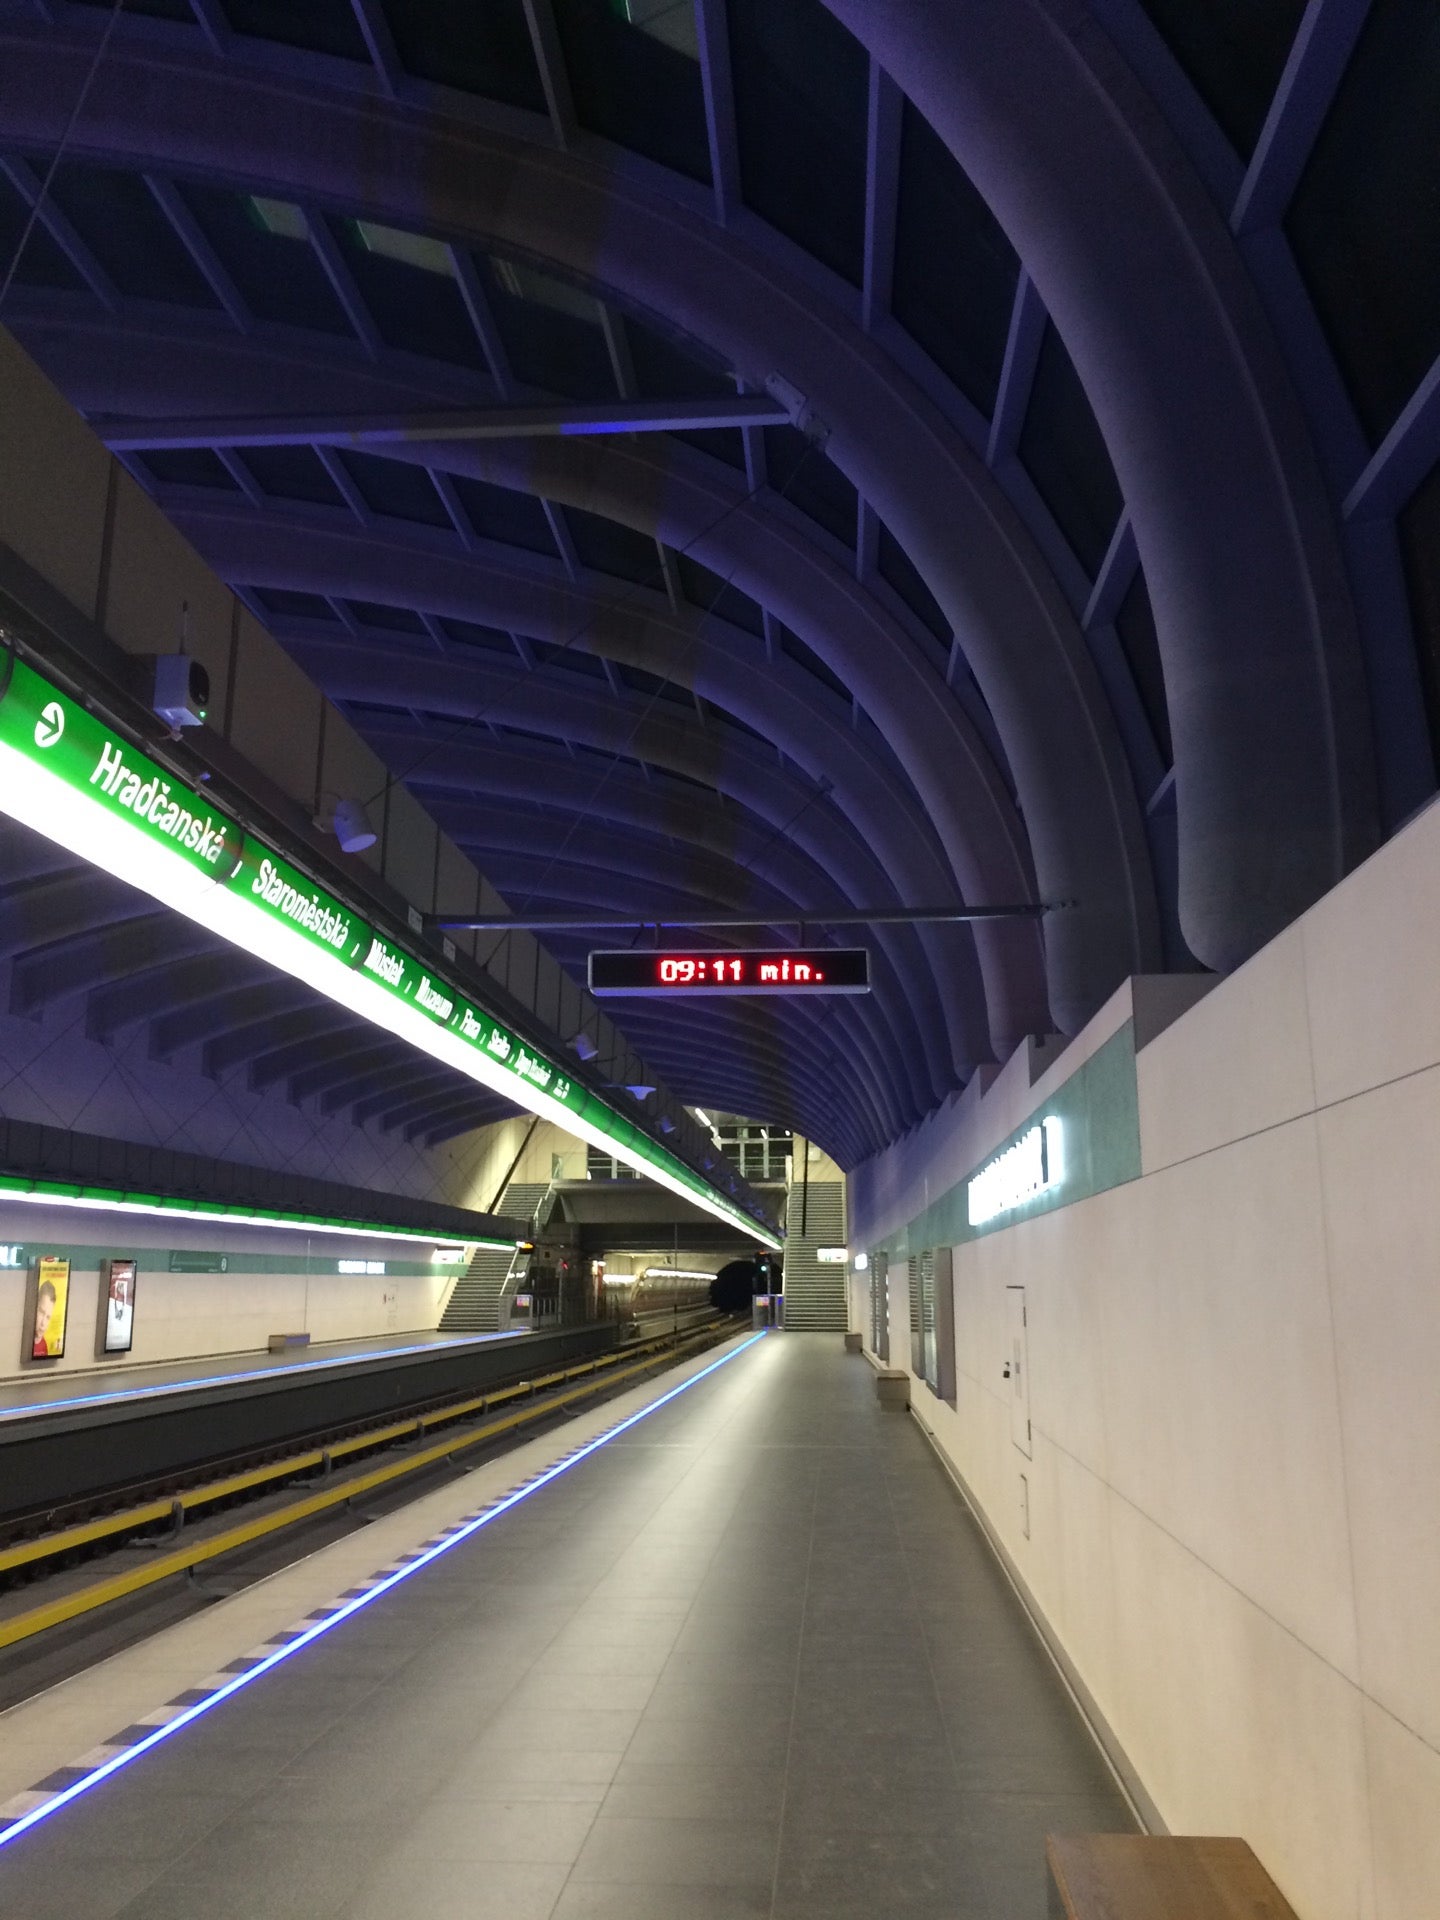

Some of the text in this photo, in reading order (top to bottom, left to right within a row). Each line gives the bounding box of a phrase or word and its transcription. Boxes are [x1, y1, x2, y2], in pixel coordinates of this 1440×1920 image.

[89, 741, 228, 865] Hradčanská
[252, 858, 351, 950] Staroměstská
[660, 959, 824, 982] 09:11 min.
